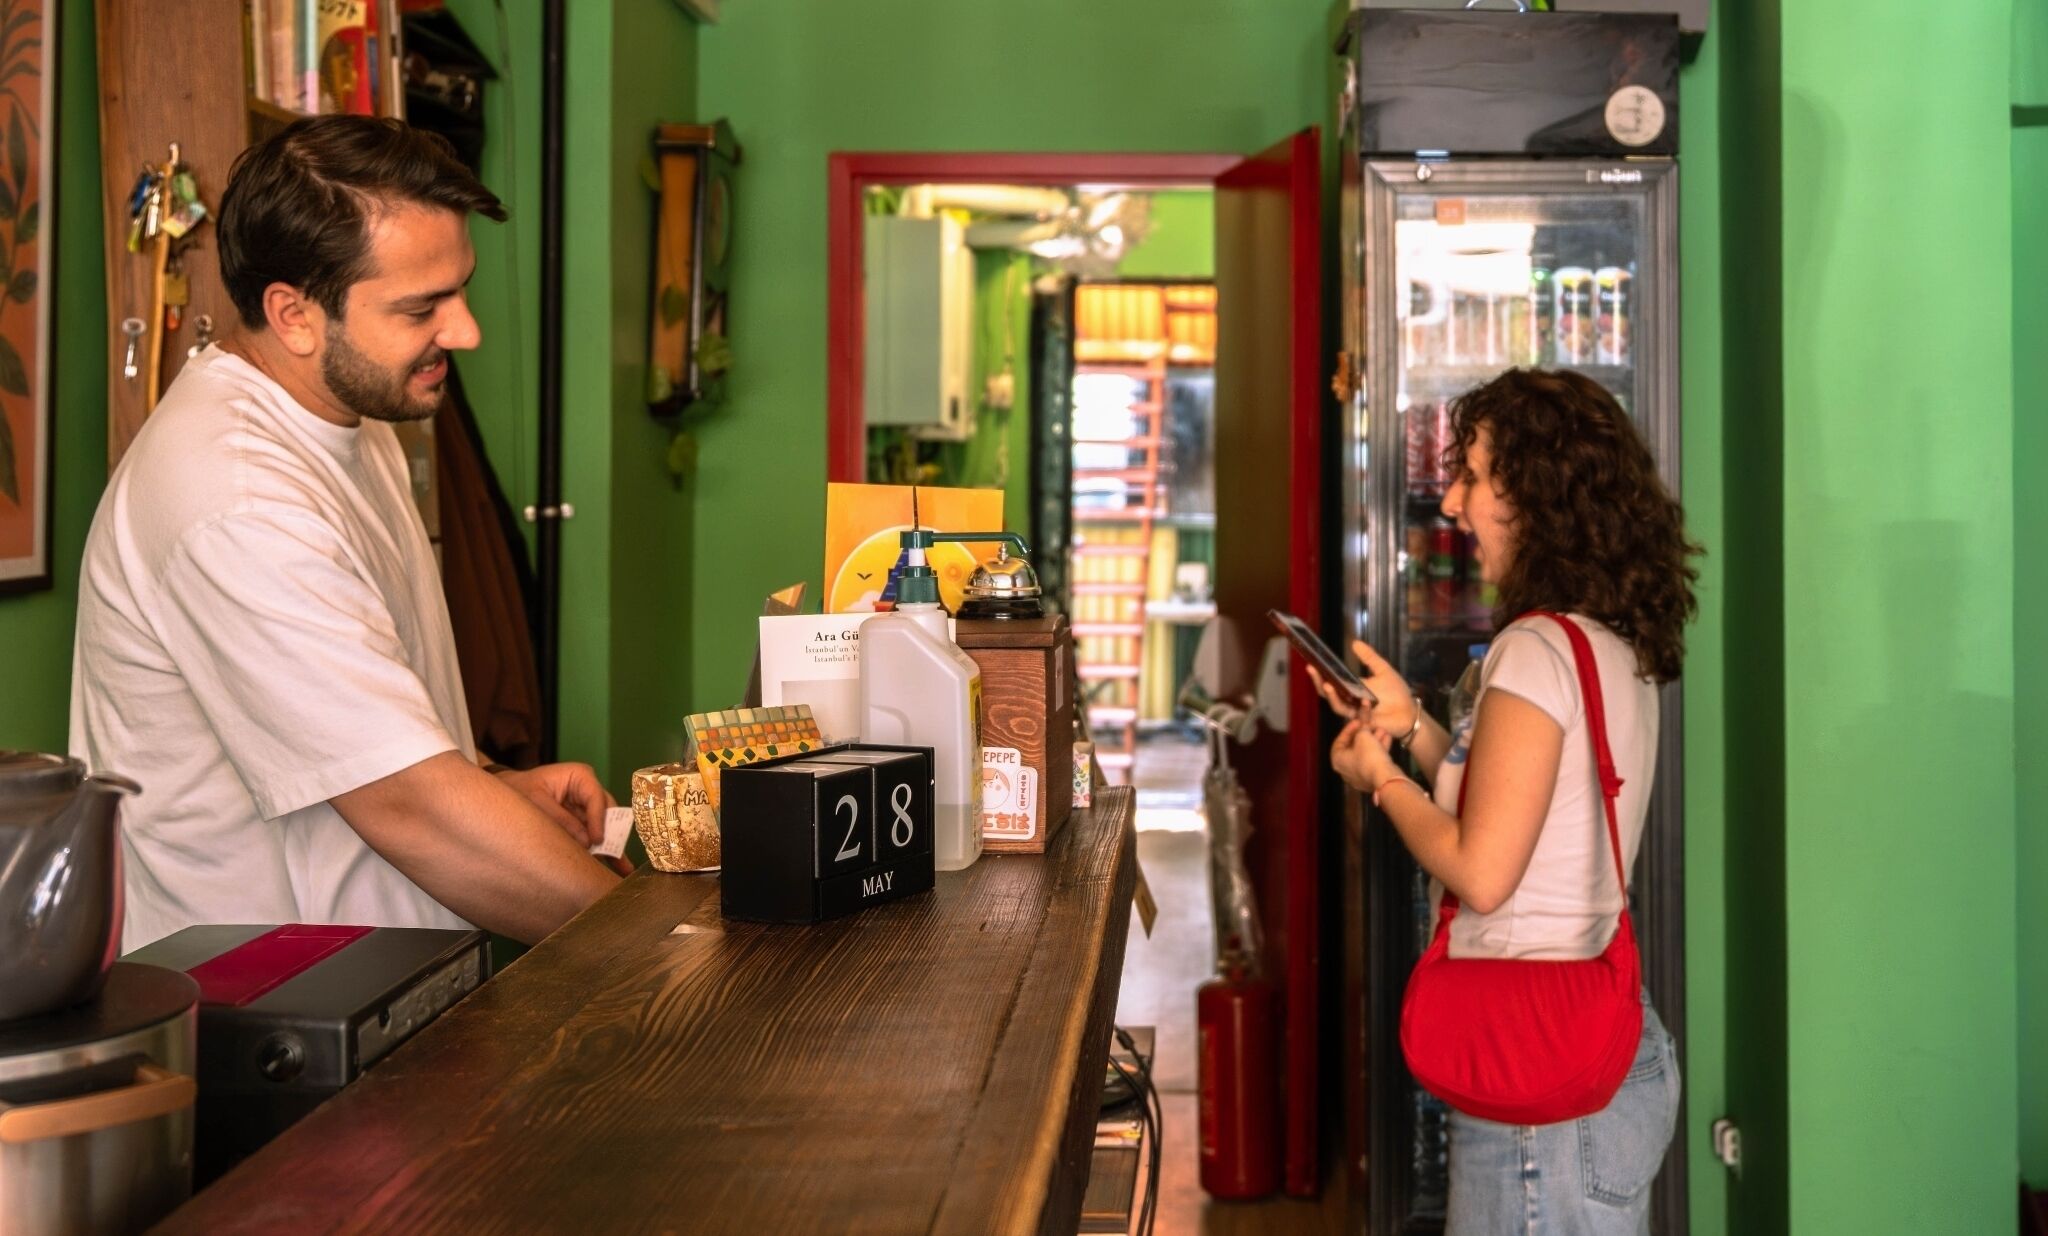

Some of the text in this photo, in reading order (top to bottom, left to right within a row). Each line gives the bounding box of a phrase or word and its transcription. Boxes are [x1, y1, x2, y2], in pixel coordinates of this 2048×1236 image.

[814, 630, 859, 641] Ara Gü
[862, 870, 894, 898] MAY
